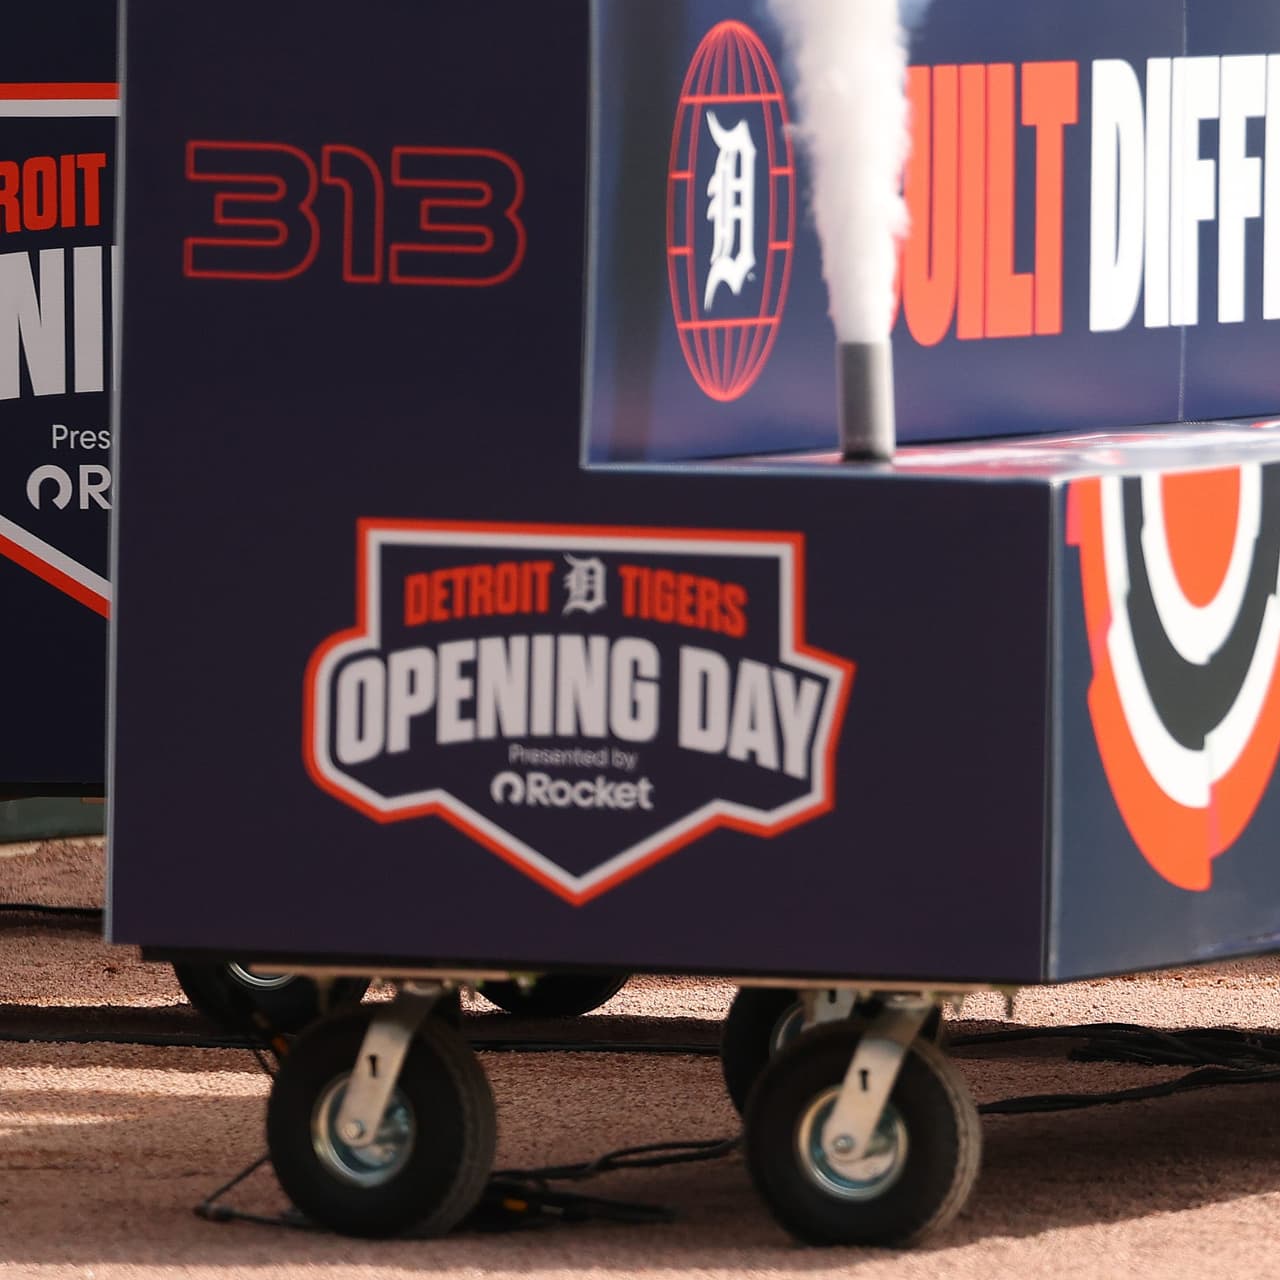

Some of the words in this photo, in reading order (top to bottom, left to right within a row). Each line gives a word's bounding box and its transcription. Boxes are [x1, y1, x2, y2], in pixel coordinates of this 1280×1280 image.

[183, 139, 526, 288] 313
[704, 111, 756, 311] D
[892, 60, 1079, 347] UILT
[404, 561, 554, 627] DETROIT
[618, 564, 748, 638] TIGERS
[336, 634, 660, 766] OPENING
[678, 645, 821, 780] DAY
[508, 743, 608, 768] Presented
[611, 747, 637, 771] by
[525, 771, 655, 810] Rocket
